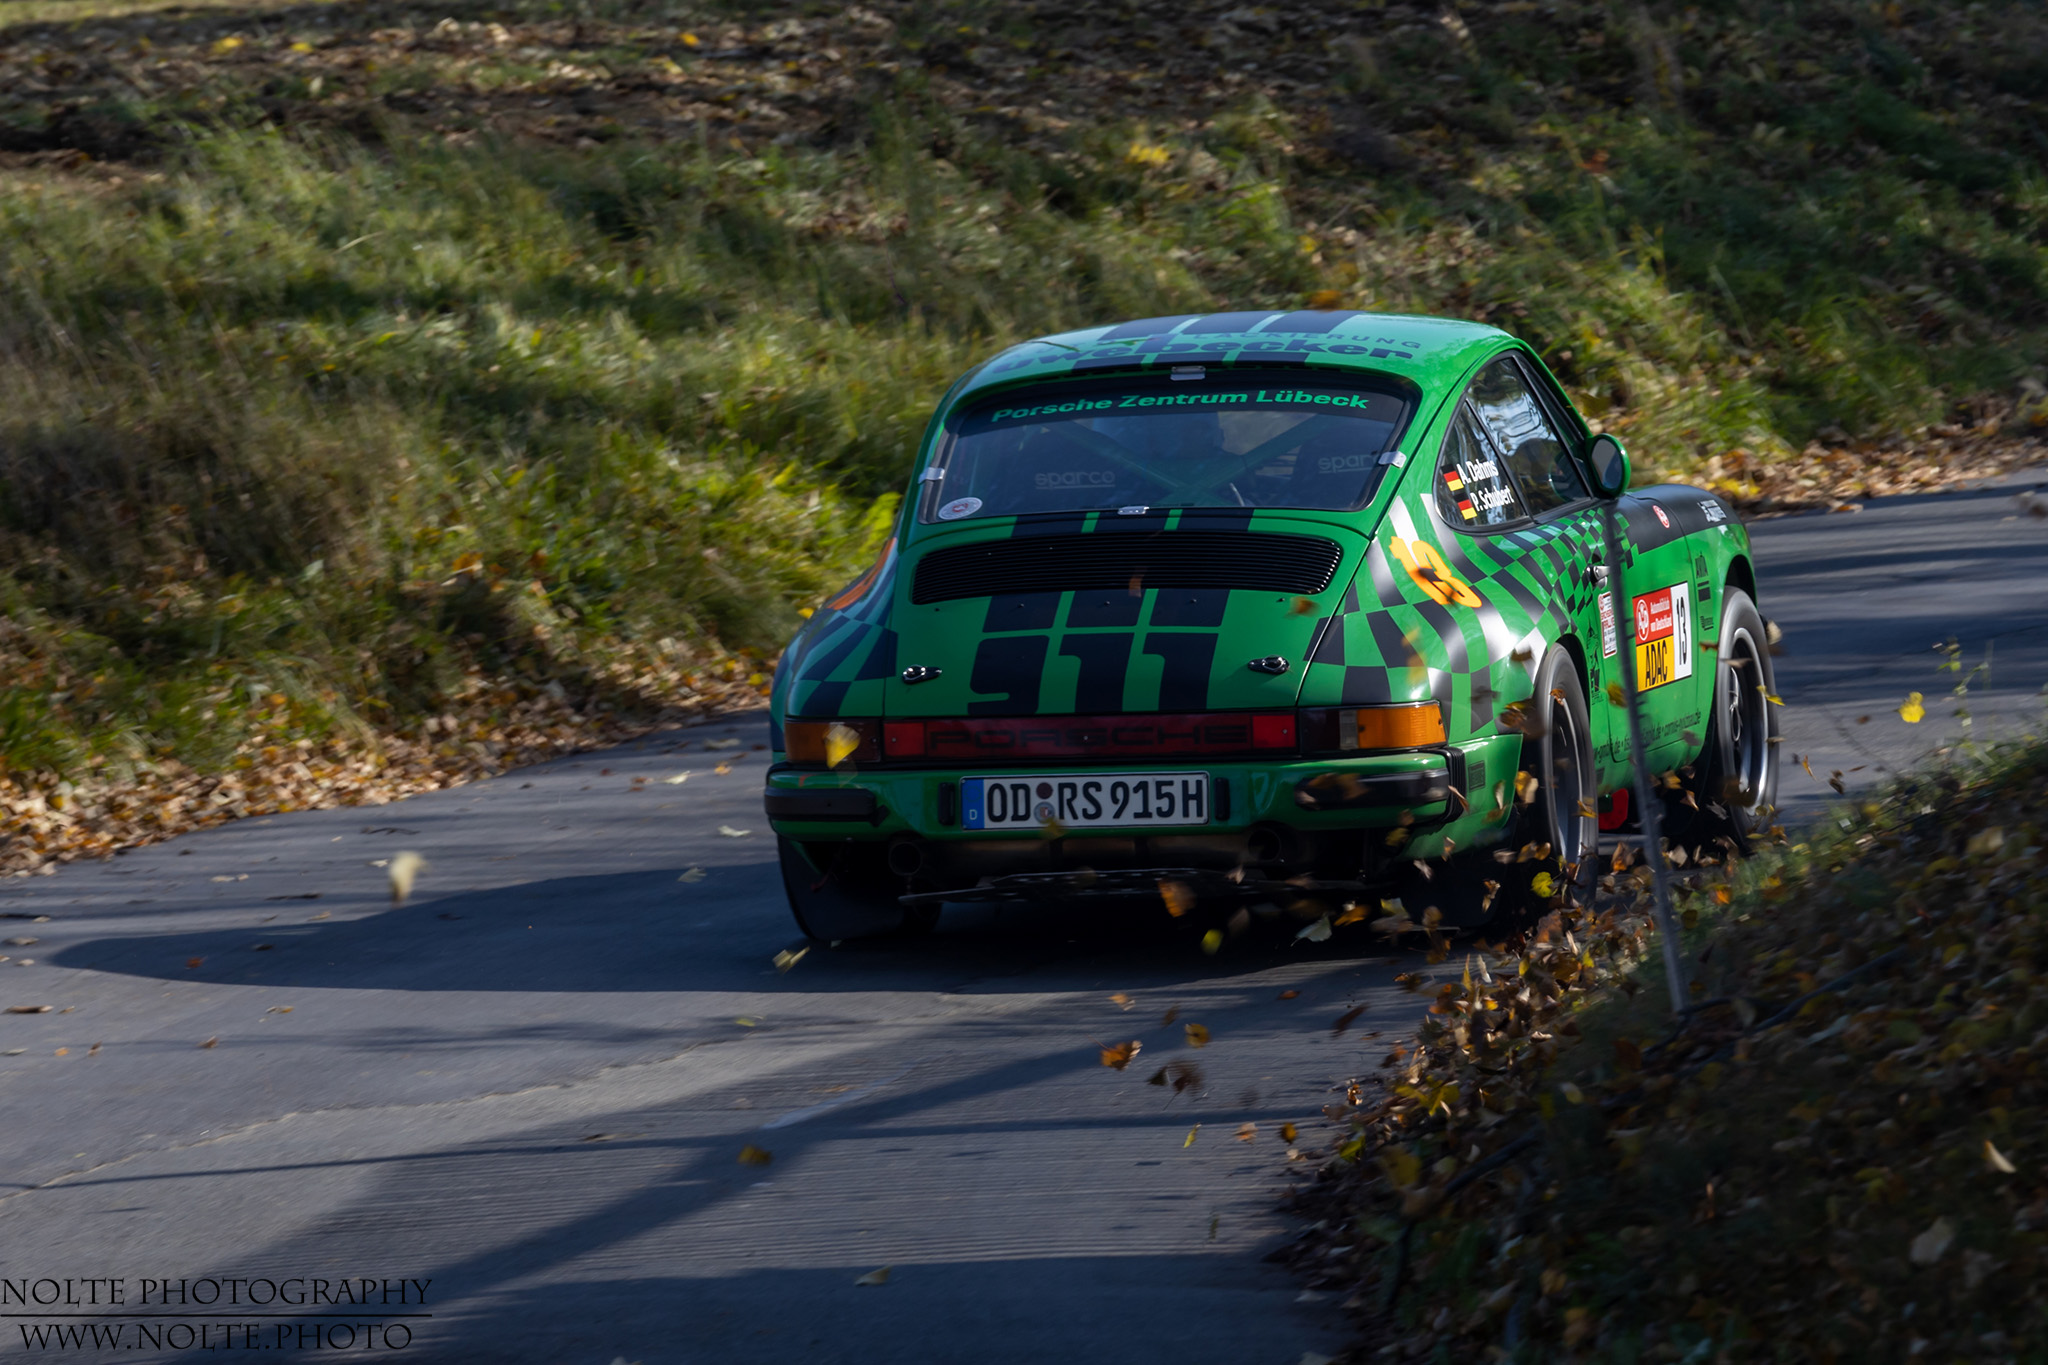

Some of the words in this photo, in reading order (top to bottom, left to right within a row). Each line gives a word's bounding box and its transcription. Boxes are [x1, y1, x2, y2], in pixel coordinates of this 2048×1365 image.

[991, 399, 1112, 422] Porsche
[1118, 393, 1248, 409] Zentrum
[1255, 390, 1369, 409] Lübeck
[1318, 454, 1379, 473] spar
[1456, 463, 1472, 485] A.
[1465, 458, 1499, 482] Dahms
[1035, 471, 1116, 490] sparco
[1478, 485, 1515, 510] Schubert
[1389, 536, 1482, 608] 13
[1676, 596, 1688, 666] 13
[967, 633, 1219, 716] 911
[1645, 639, 1668, 688] ADAC
[930, 724, 1249, 749] PORSCHE
[987, 783, 1031, 822] OD
[1058, 781, 1102, 820] RS
